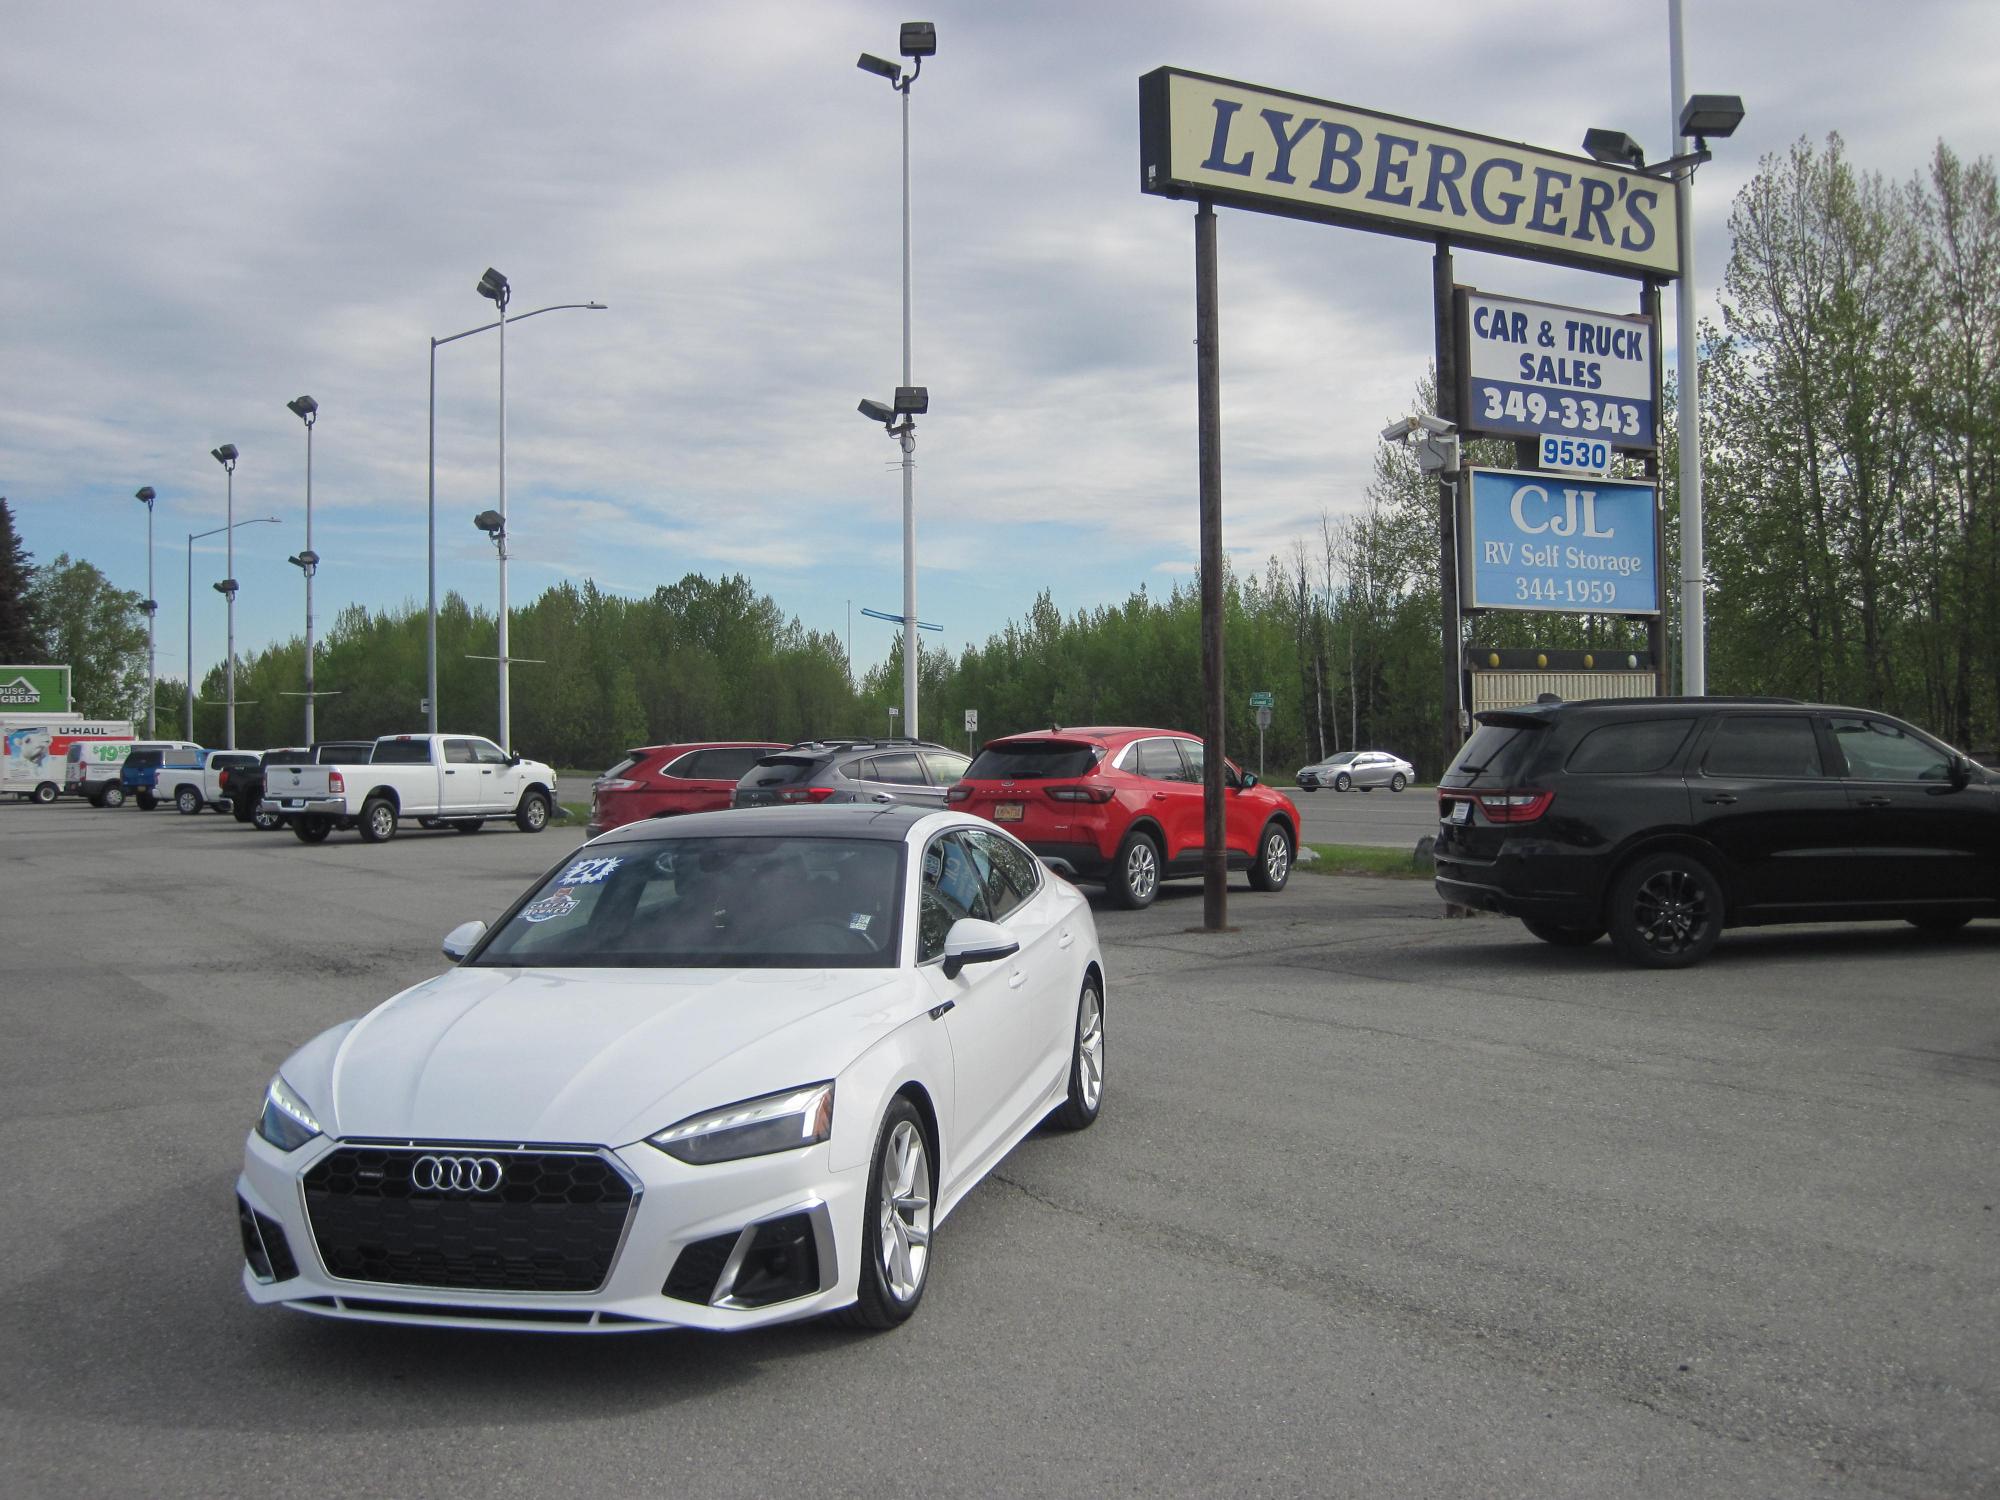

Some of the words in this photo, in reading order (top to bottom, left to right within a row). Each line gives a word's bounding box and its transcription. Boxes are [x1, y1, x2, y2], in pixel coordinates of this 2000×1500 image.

[1200, 98, 1658, 252] LYBERGER'S
[1473, 306, 1528, 344] CAR
[1537, 320, 1555, 348] &
[1565, 320, 1643, 361] TRUCK
[1519, 352, 1602, 389] SALES
[1482, 387, 1640, 436] 349-3343
[1543, 438, 1606, 469] 9530
[1510, 485, 1614, 538] CJL
[1484, 541, 1513, 564] RV
[1521, 543, 1558, 567] Self
[1566, 546, 1642, 576] Storage
[1516, 577, 1616, 603] 344-1959
[1, 695, 40, 703] GREEN
